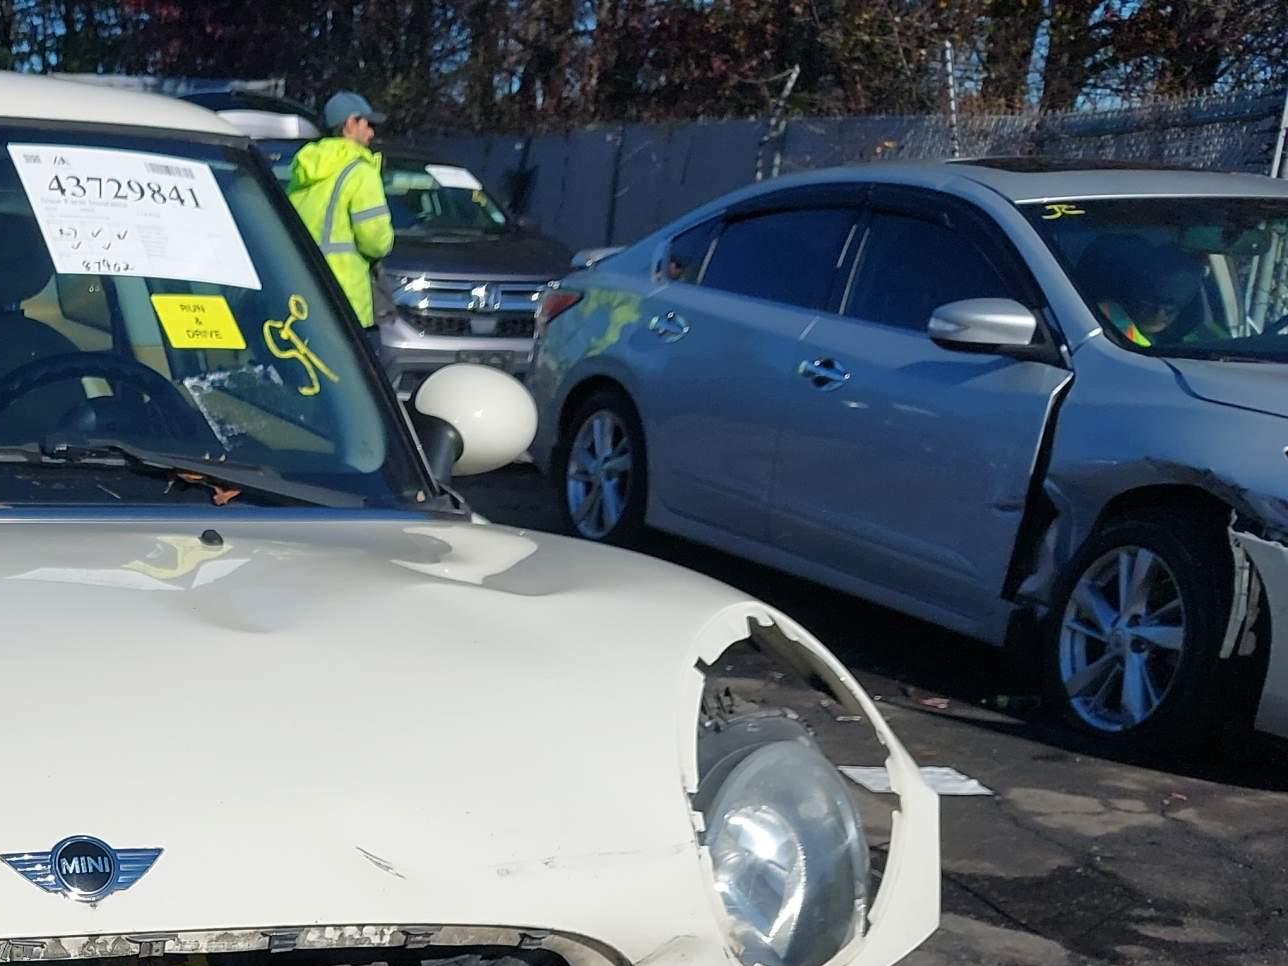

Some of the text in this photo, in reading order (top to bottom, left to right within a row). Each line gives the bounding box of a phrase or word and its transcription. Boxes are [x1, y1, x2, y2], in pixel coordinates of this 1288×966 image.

[48, 174, 202, 209] 43729841
[179, 304, 206, 313] RUN
[193, 317, 203, 325] &
[186, 330, 224, 339] DRIVE
[60, 855, 111, 875] MINI
